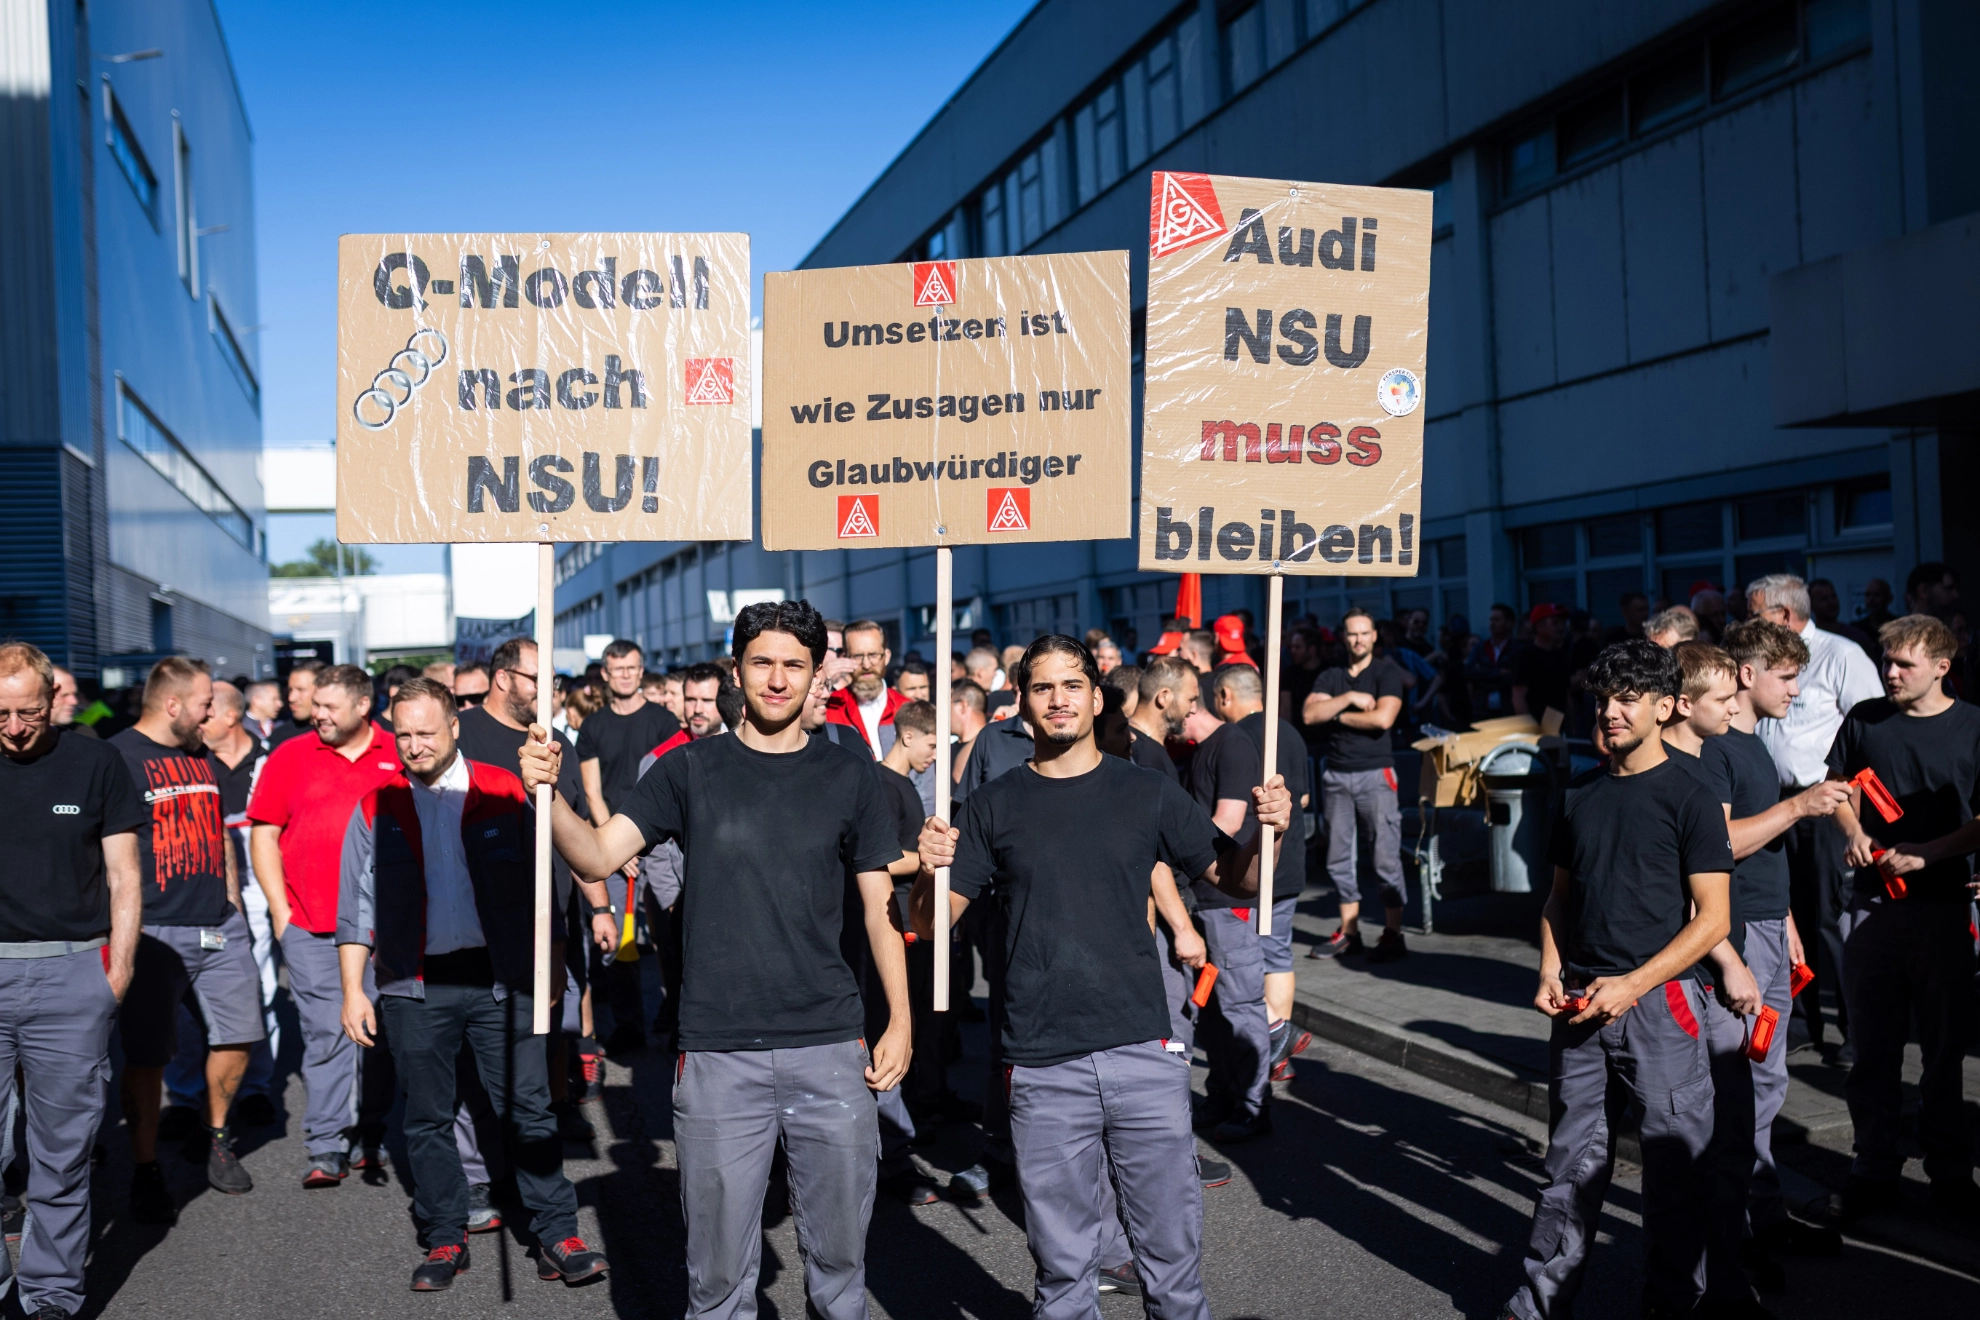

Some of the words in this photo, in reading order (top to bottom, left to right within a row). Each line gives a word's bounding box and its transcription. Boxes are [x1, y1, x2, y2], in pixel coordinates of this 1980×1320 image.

[1223, 208, 1378, 272] Audi
[373, 251, 710, 313] Q-Modell
[824, 315, 1007, 348] Umsetzen
[1020, 309, 1068, 337] ist
[1224, 307, 1372, 369] NSU
[458, 353, 647, 411] nach
[1382, 369, 1416, 382] PERSPEKTIVE
[791, 396, 856, 424] wie
[867, 391, 1025, 423] Zusagen
[1039, 388, 1102, 412] nur
[808, 451, 1082, 488] Glaubwürdiger
[1200, 419, 1382, 467] muss
[467, 451, 659, 514] NSU!
[1155, 506, 1414, 566] bleiben!
